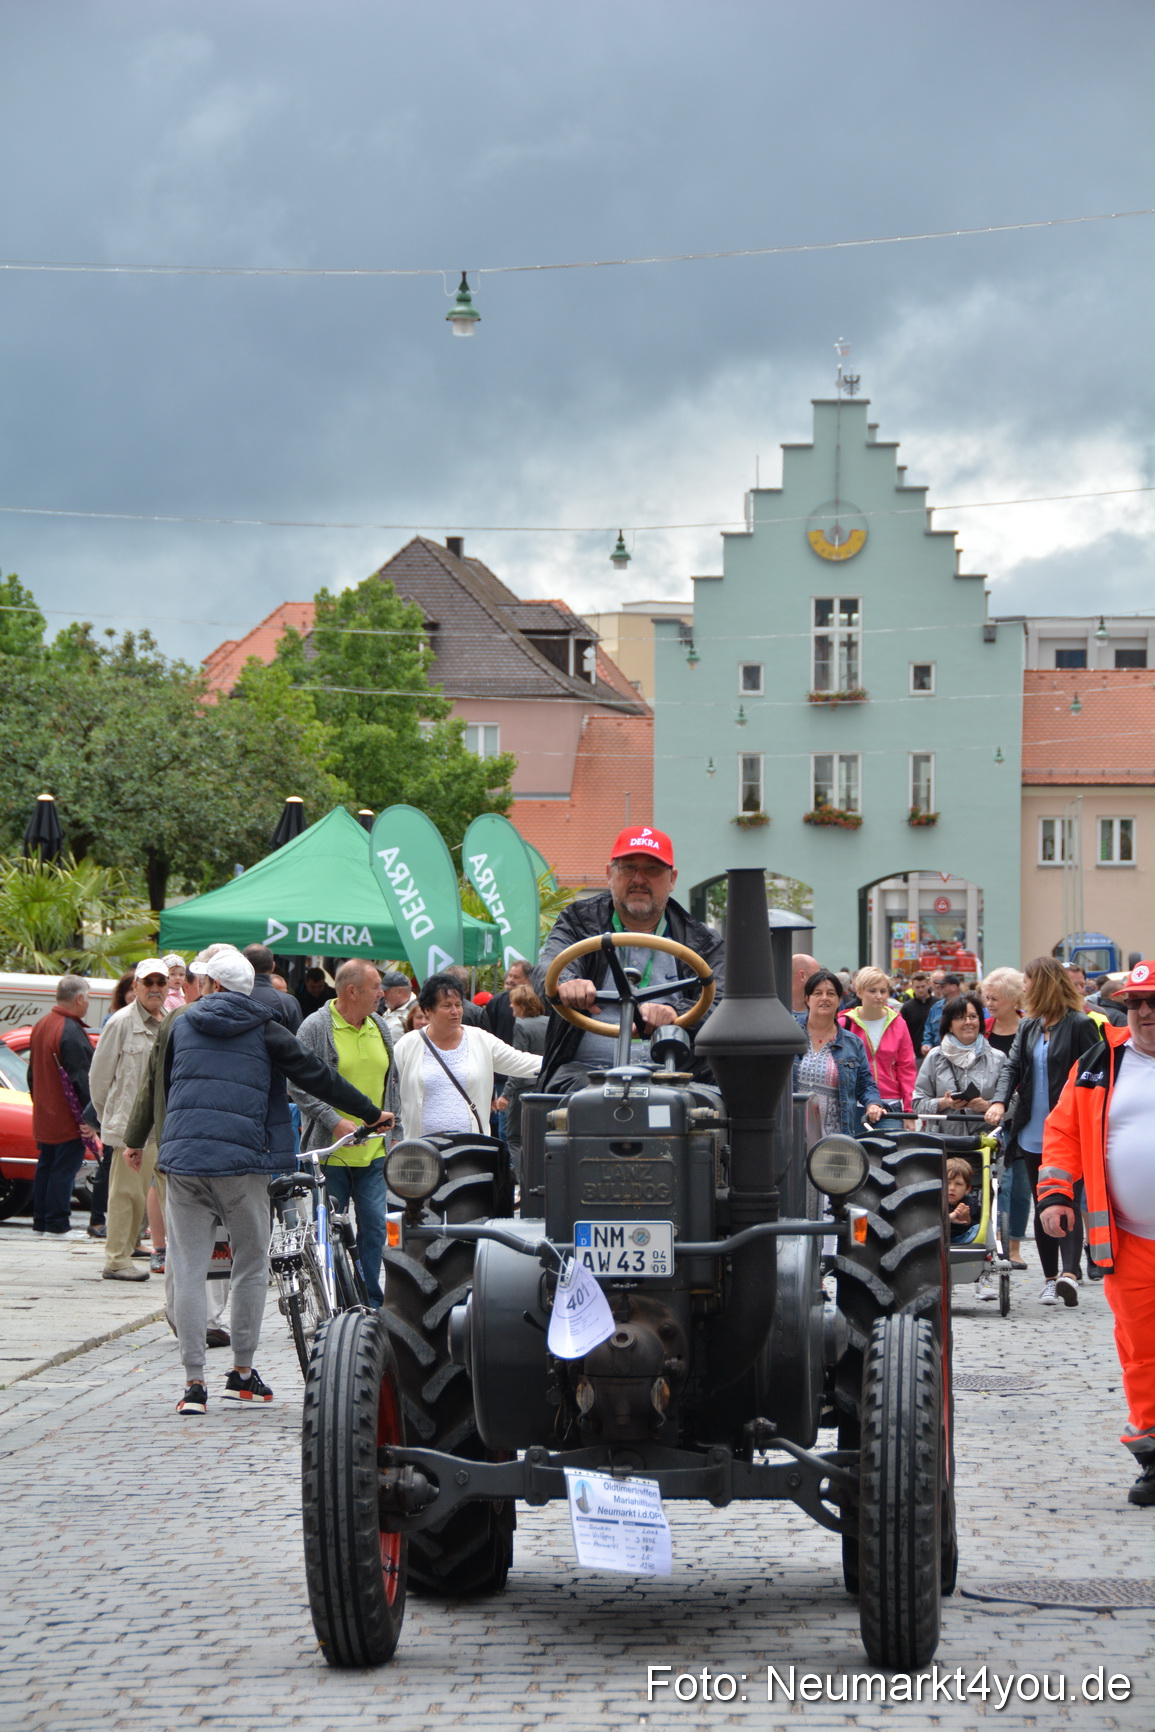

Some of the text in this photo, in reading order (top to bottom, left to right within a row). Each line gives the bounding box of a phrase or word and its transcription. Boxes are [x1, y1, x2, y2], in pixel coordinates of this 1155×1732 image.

[630, 838, 659, 850] DEKRA
[297, 922, 374, 947] DEKRA
[601, 1164, 653, 1181] LANZ
[583, 1182, 670, 1200] BULLDOG
[580, 1237, 587, 1246] D
[594, 1226, 624, 1248] NM
[583, 1250, 645, 1272] AW 43
[653, 1250, 666, 1259] 04
[653, 1264, 666, 1273] 09
[566, 1281, 590, 1310] 401
[603, 1481, 657, 1498] Oldtimertreffen
[597, 1506, 636, 1518] Neumarkt
